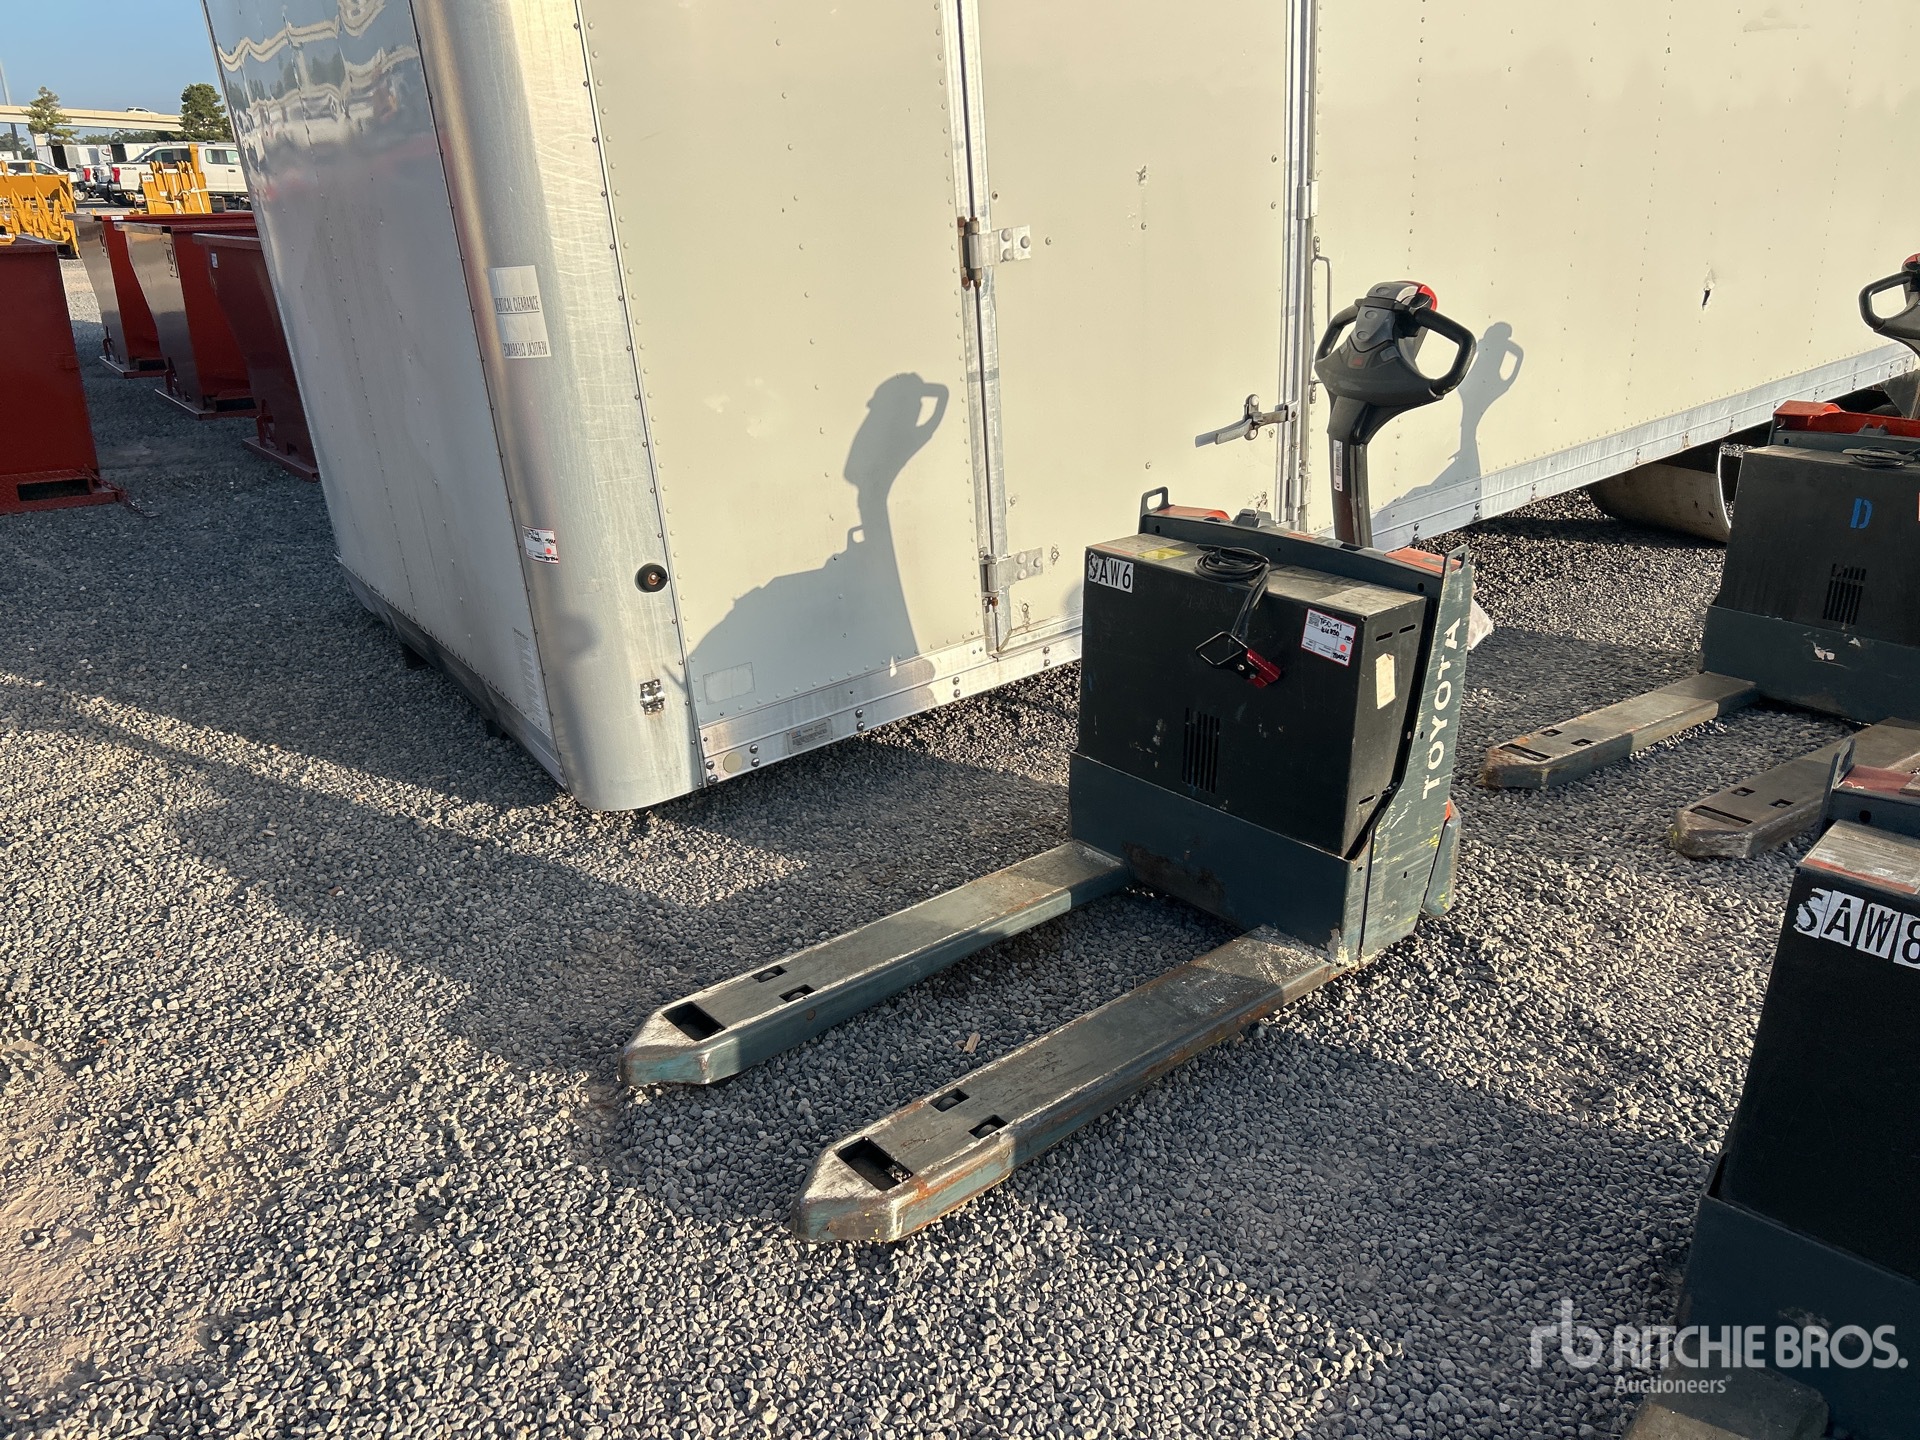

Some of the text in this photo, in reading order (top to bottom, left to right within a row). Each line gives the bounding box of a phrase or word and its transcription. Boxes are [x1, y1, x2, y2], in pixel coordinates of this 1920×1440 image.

[494, 295, 540, 312] VERTICAL CLEARANCE
[1850, 498, 1873, 529] D
[1422, 617, 1461, 800] TOYOTA
[1798, 891, 1920, 964] SAW8
